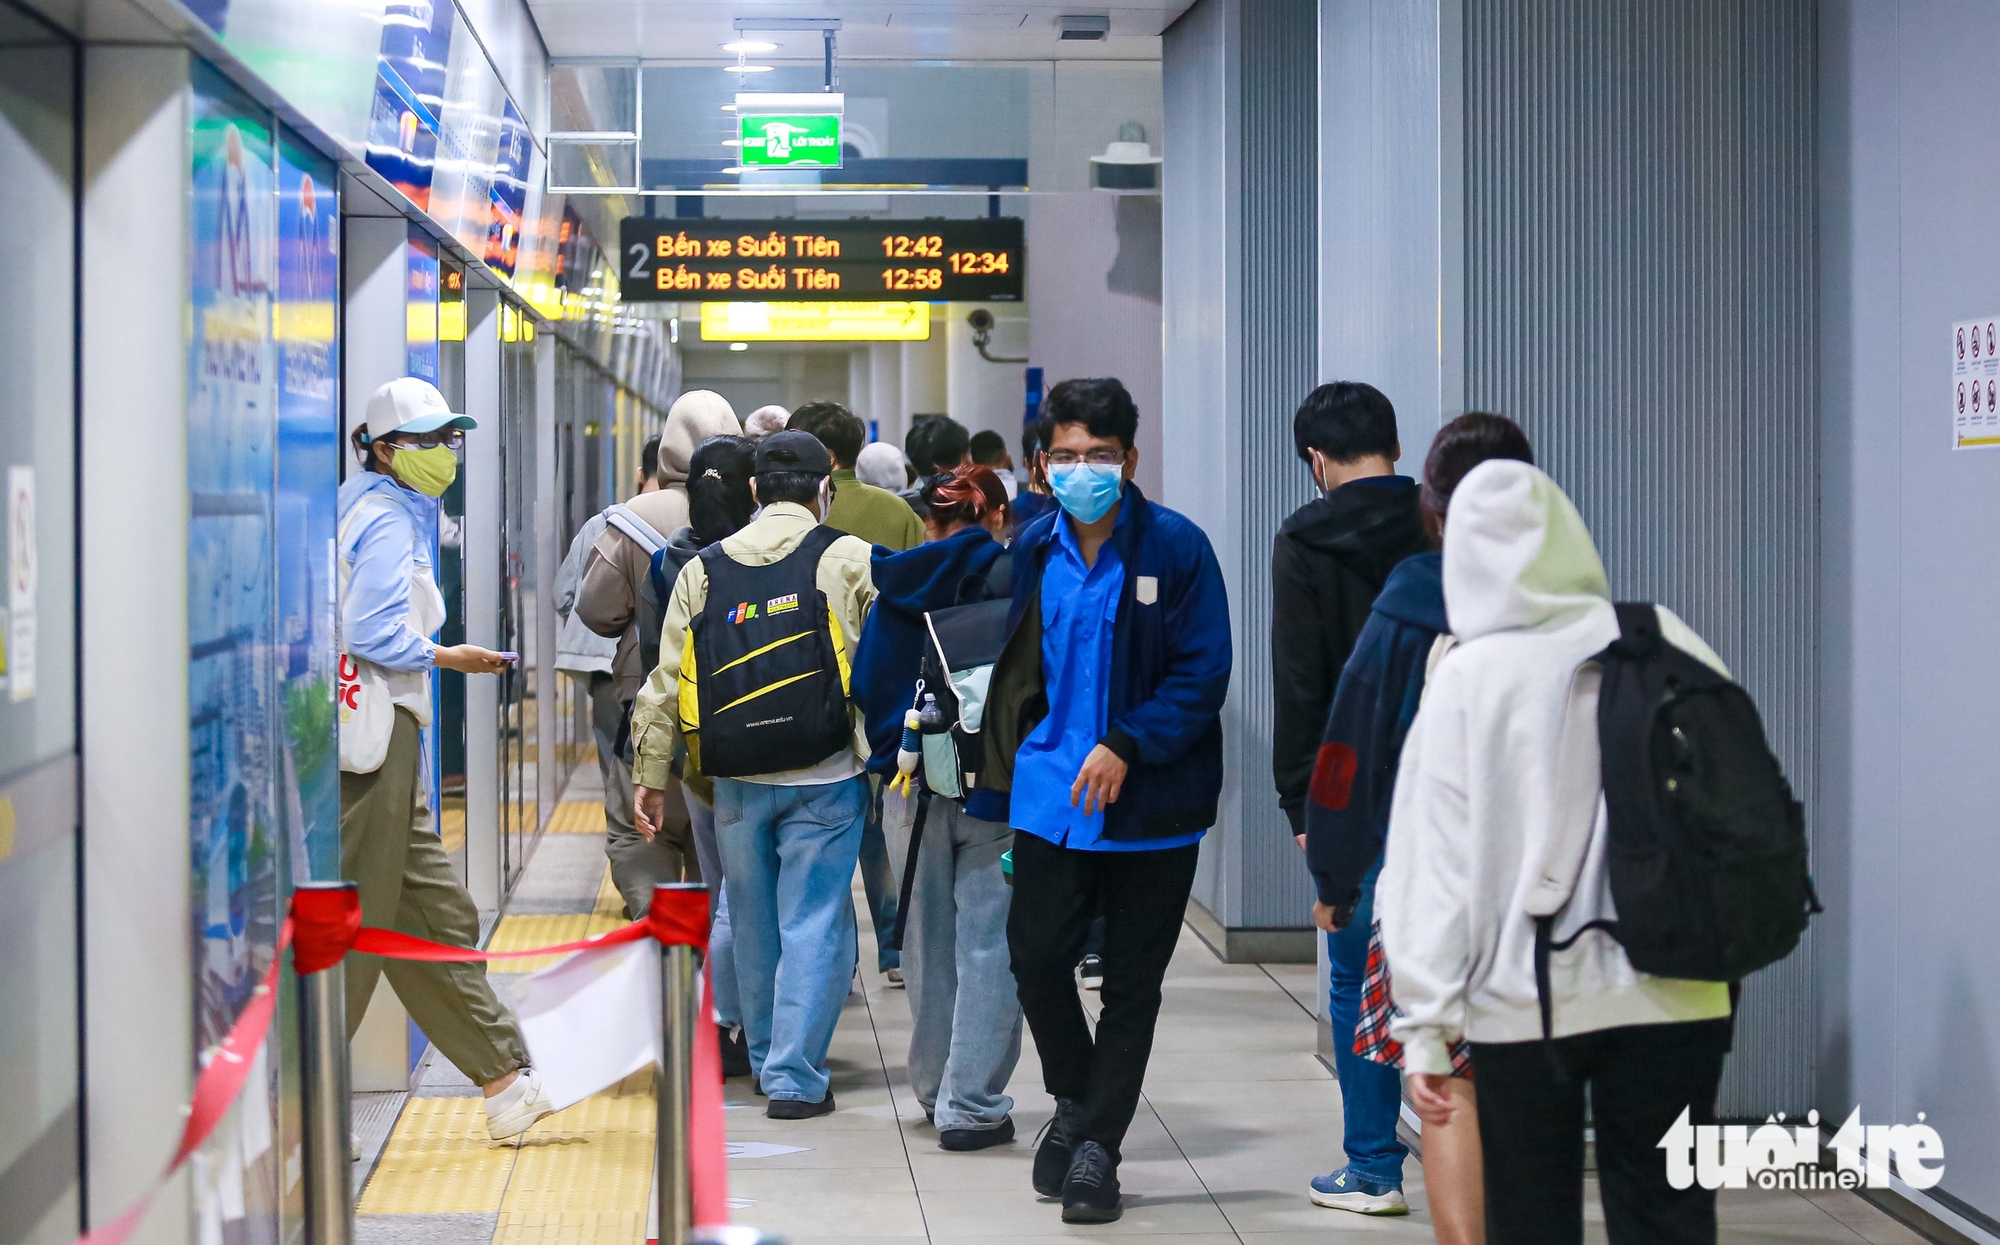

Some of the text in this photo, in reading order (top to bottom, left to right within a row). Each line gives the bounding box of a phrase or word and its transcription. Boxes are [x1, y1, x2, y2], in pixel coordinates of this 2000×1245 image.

[656, 231, 943, 257] Bến xe Suối Tiên 12:42
[628, 243, 650, 279] 2
[948, 252, 1010, 274] 12:34
[656, 264, 943, 290] Bến xe Suối Tiên 12:58
[769, 595, 797, 606] ARENA
[727, 604, 757, 622] FPT
